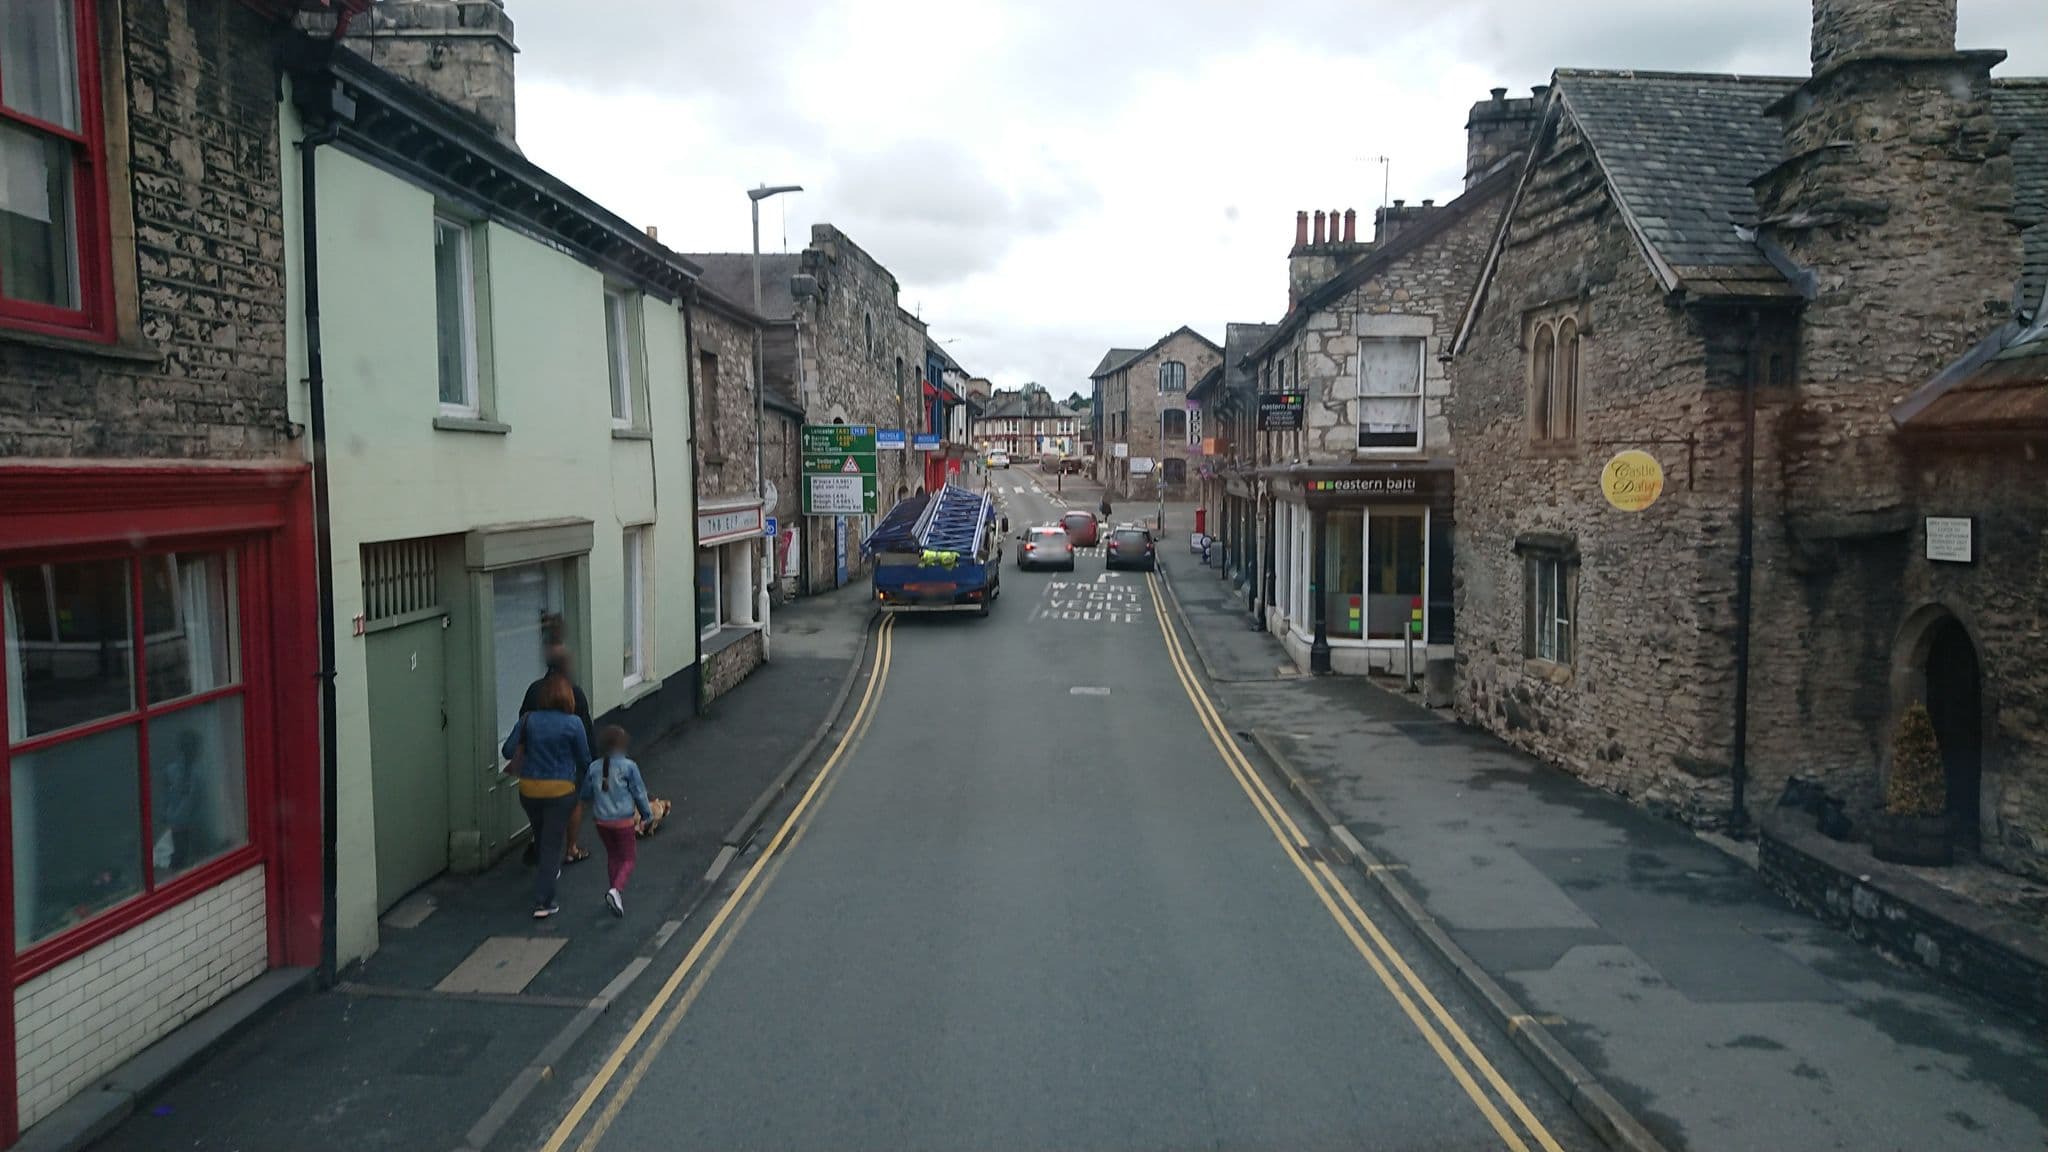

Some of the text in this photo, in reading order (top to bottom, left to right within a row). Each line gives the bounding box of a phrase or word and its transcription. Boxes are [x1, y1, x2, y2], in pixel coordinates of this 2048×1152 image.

[1611, 461, 1655, 478] Castle
[1335, 477, 1416, 490] eastern balti
[1052, 591, 1142, 603] LIGHT
[1040, 610, 1144, 624] ROUTE
